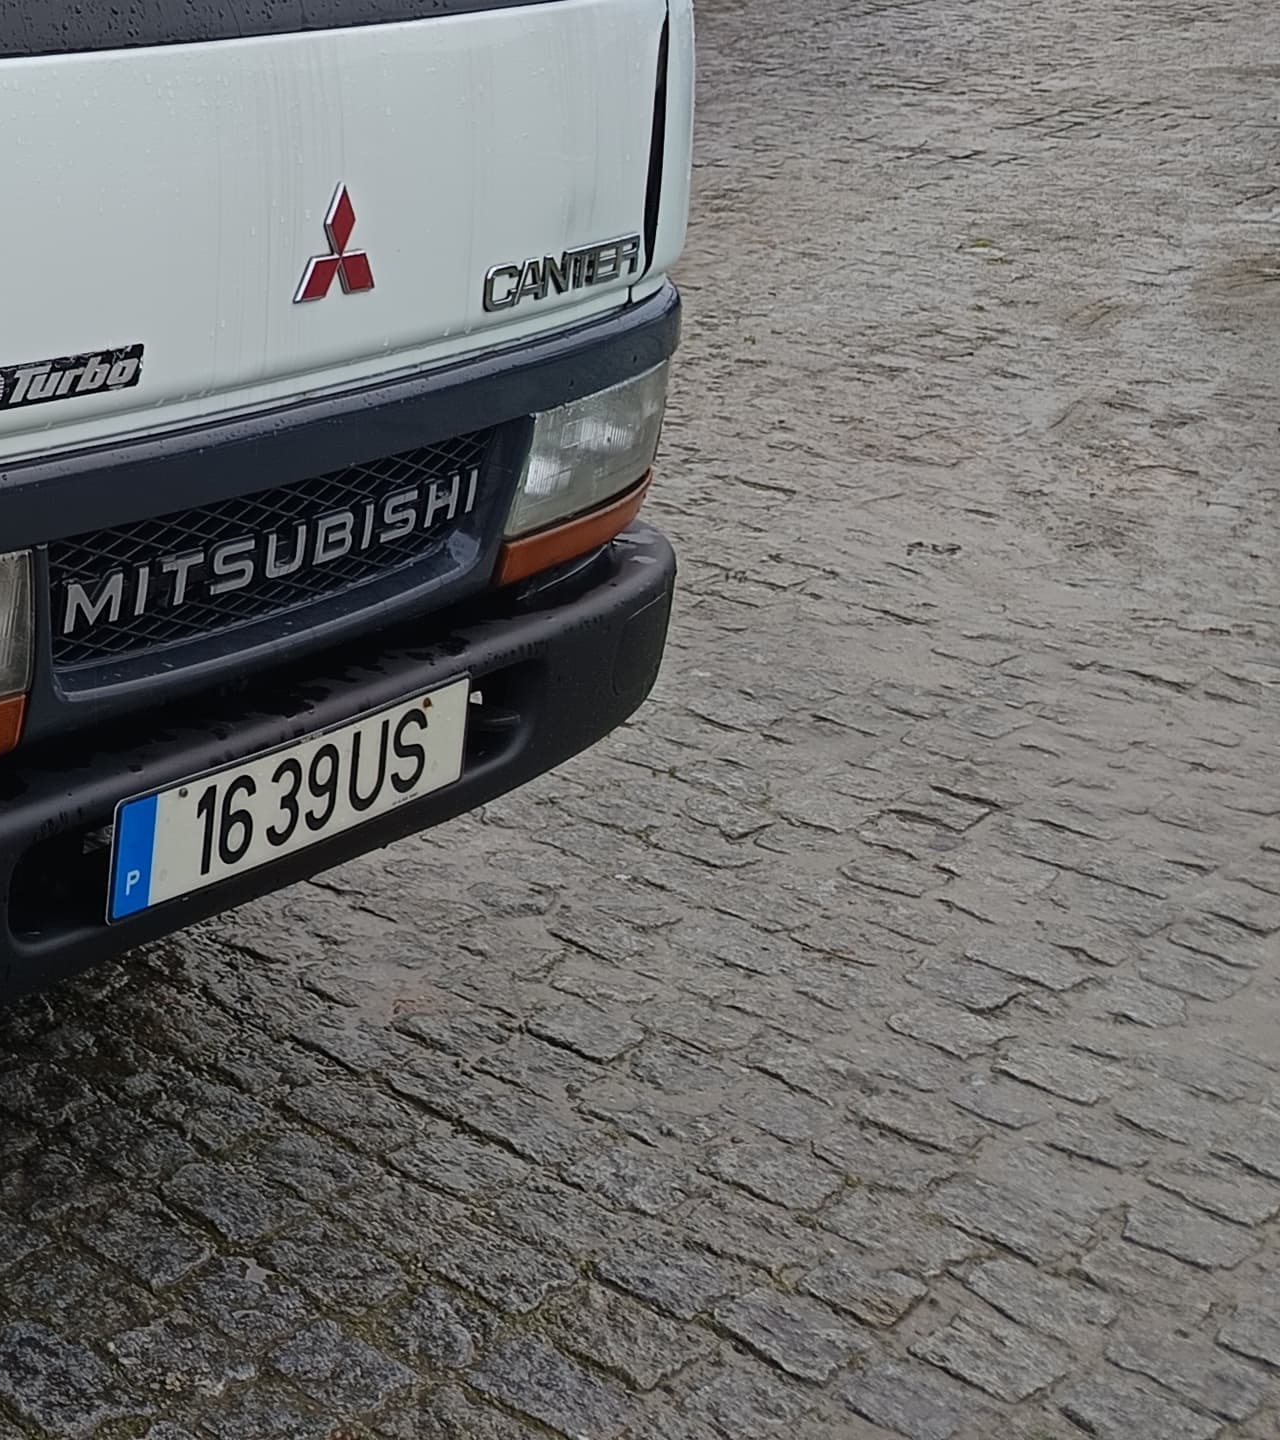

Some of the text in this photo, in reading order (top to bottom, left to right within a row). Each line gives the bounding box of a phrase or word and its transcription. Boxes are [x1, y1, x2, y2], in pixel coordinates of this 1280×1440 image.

[483, 233, 641, 312] CANTER
[8, 355, 140, 405] Turbo
[62, 467, 480, 635] MITSUBISHI
[125, 869, 140, 896] P
